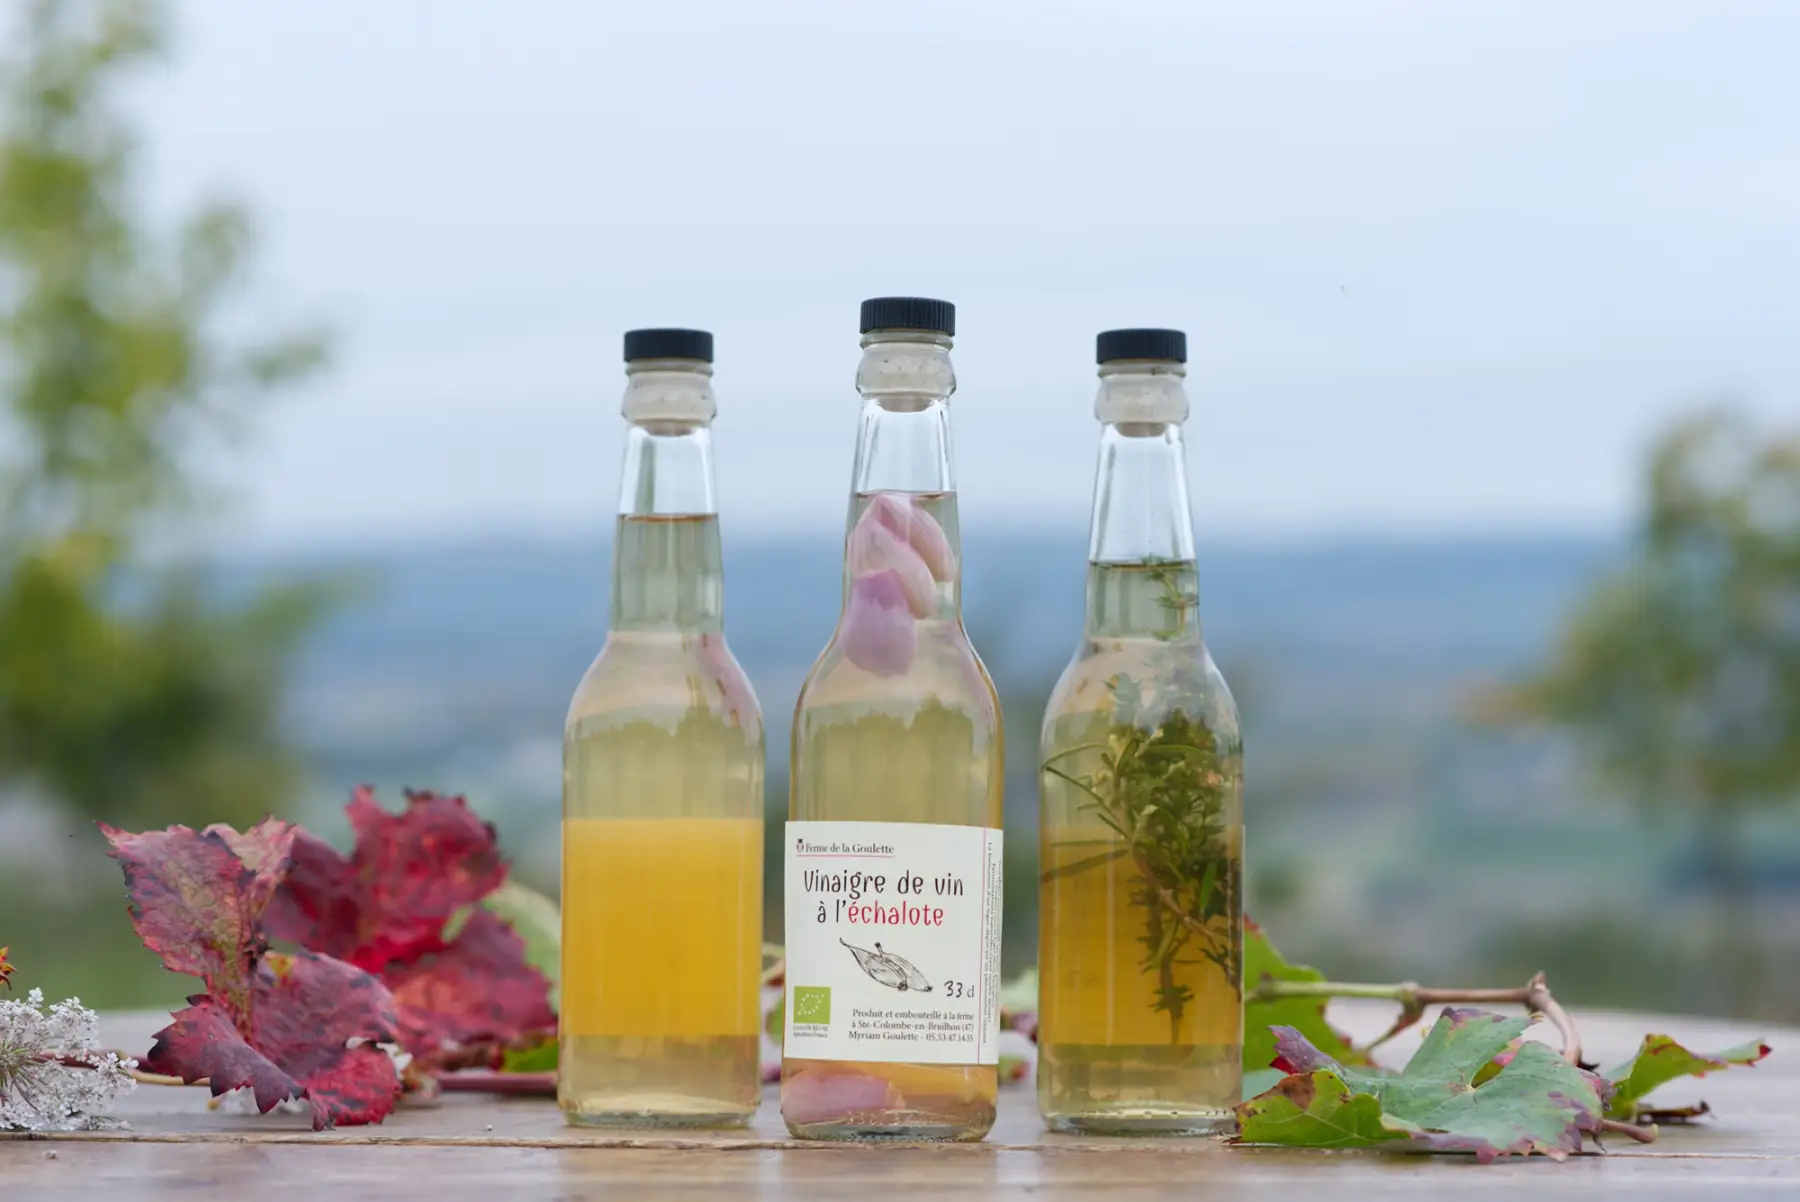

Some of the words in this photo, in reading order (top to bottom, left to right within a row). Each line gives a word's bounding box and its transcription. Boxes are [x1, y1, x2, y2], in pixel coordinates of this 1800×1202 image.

[805, 843, 828, 853] Ferme
[830, 842, 840, 853] de
[852, 843, 894, 854] Goulette
[804, 869, 886, 900] Vinaigre
[897, 870, 923, 895] de
[934, 873, 963, 896] vin
[817, 901, 826, 923] à
[836, 899, 944, 926] l'échalote
[944, 980, 963, 998] 33
[852, 1008, 883, 1018] Produit
[957, 1012, 974, 1020] ferme
[848, 1030, 881, 1041] Myriam
[883, 1032, 919, 1041] Goulette
